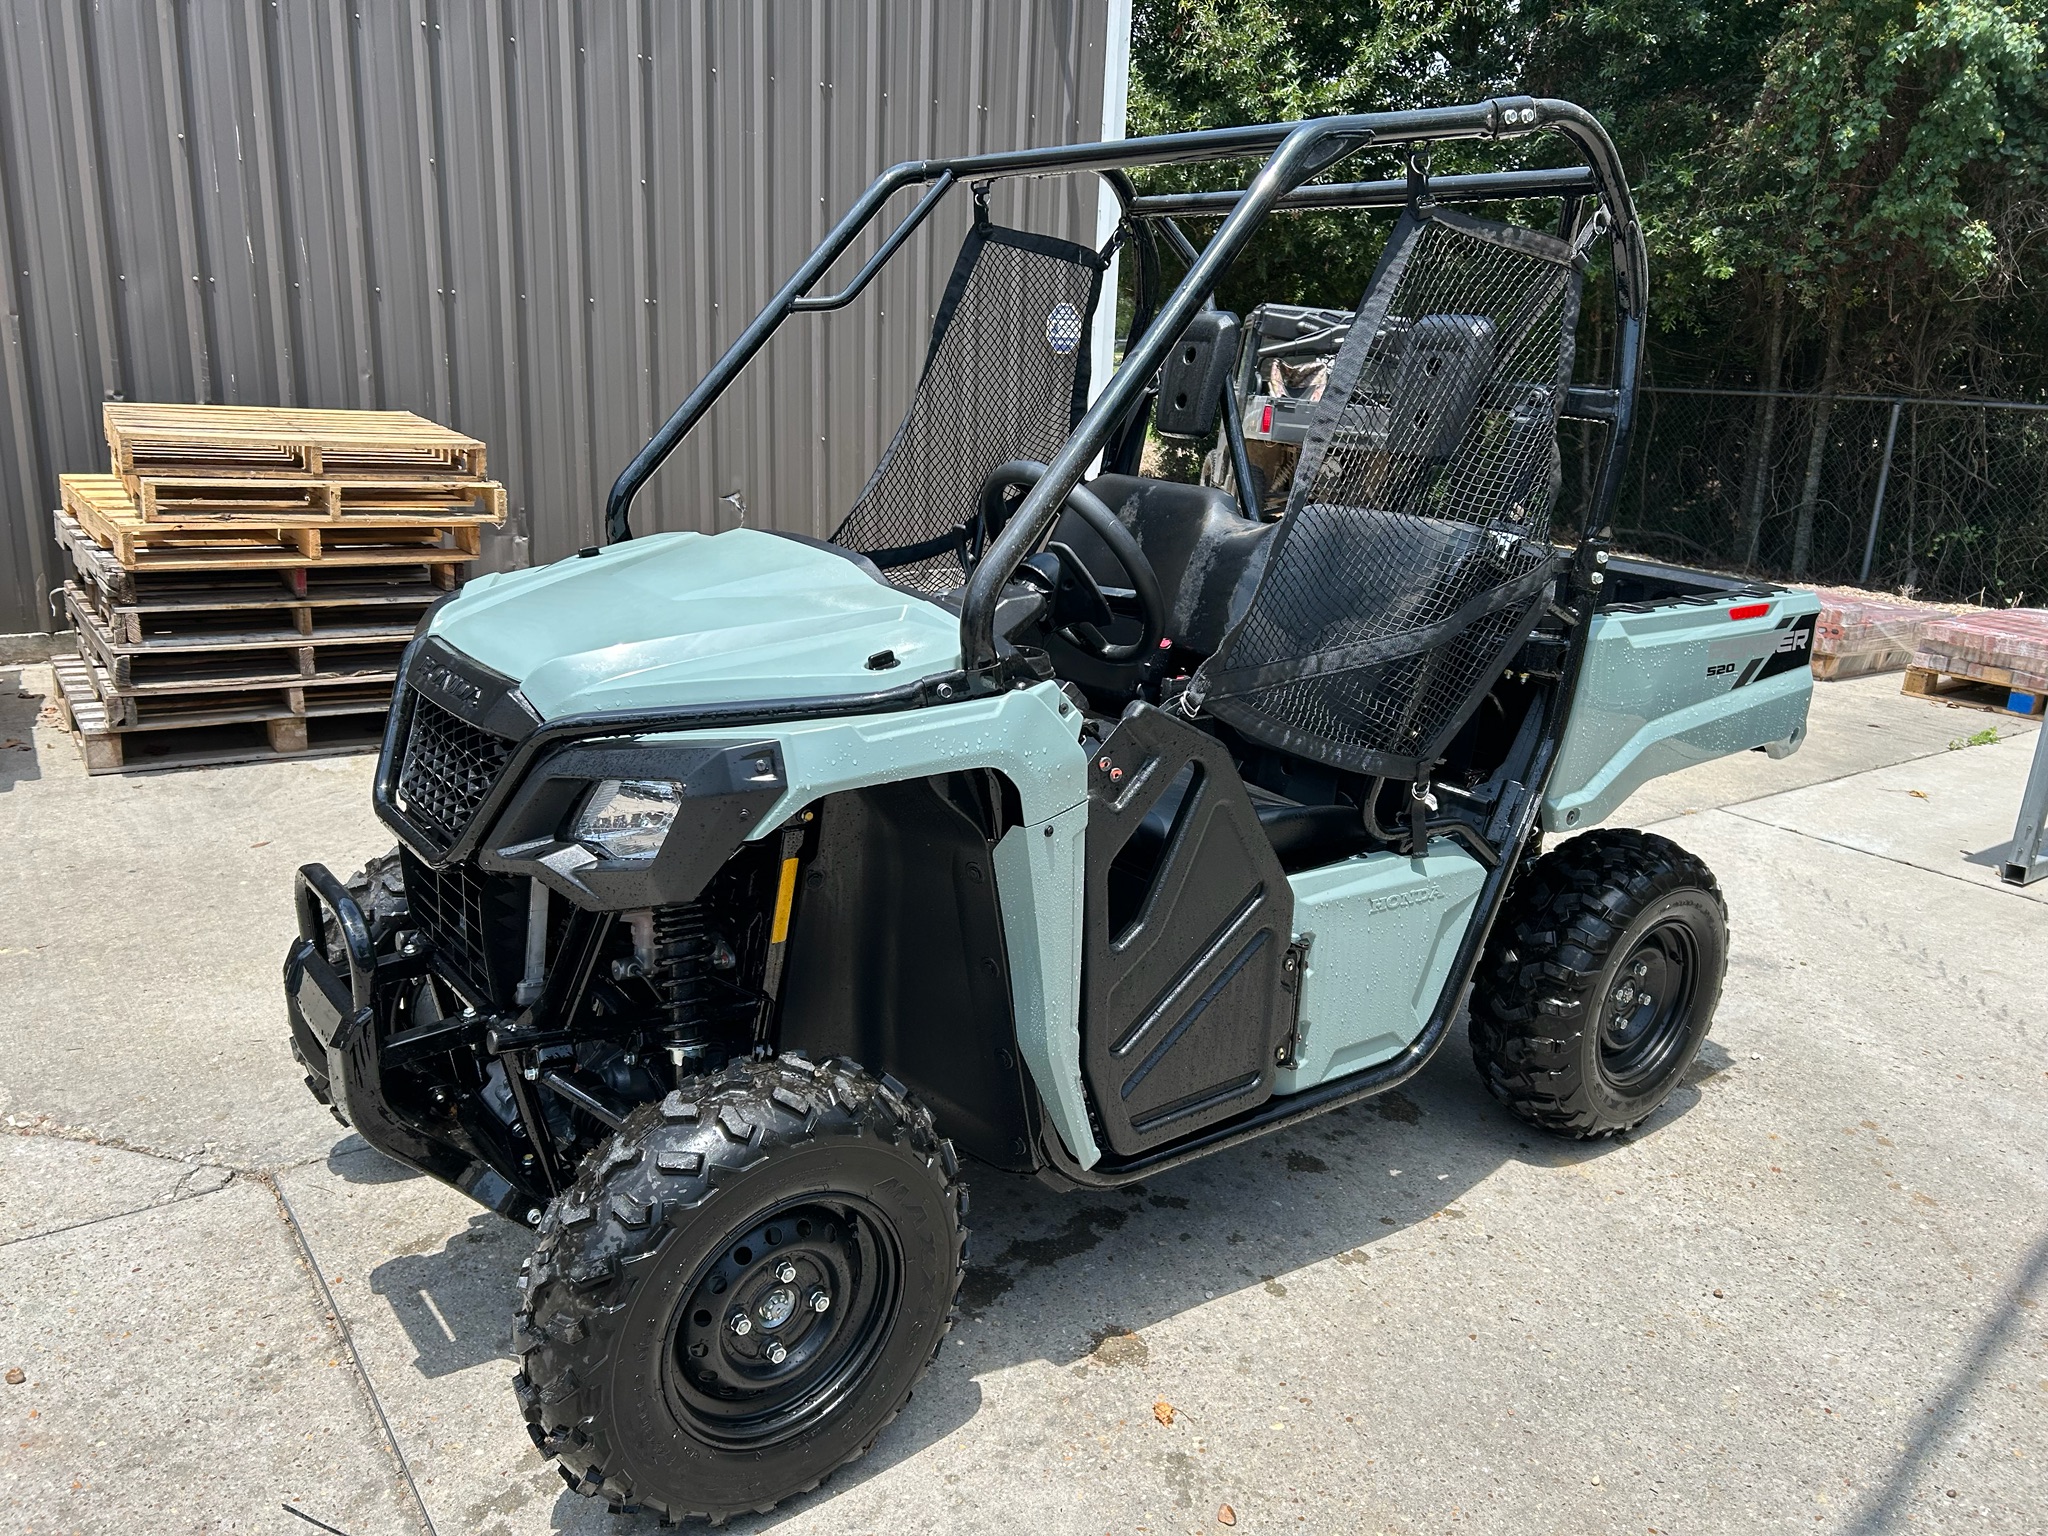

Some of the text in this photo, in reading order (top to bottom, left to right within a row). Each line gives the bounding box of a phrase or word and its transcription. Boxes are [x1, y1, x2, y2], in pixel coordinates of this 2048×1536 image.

[416, 654, 484, 711] HONDA
[1706, 663, 1736, 677] 520
[1368, 884, 1445, 915] HONDA
